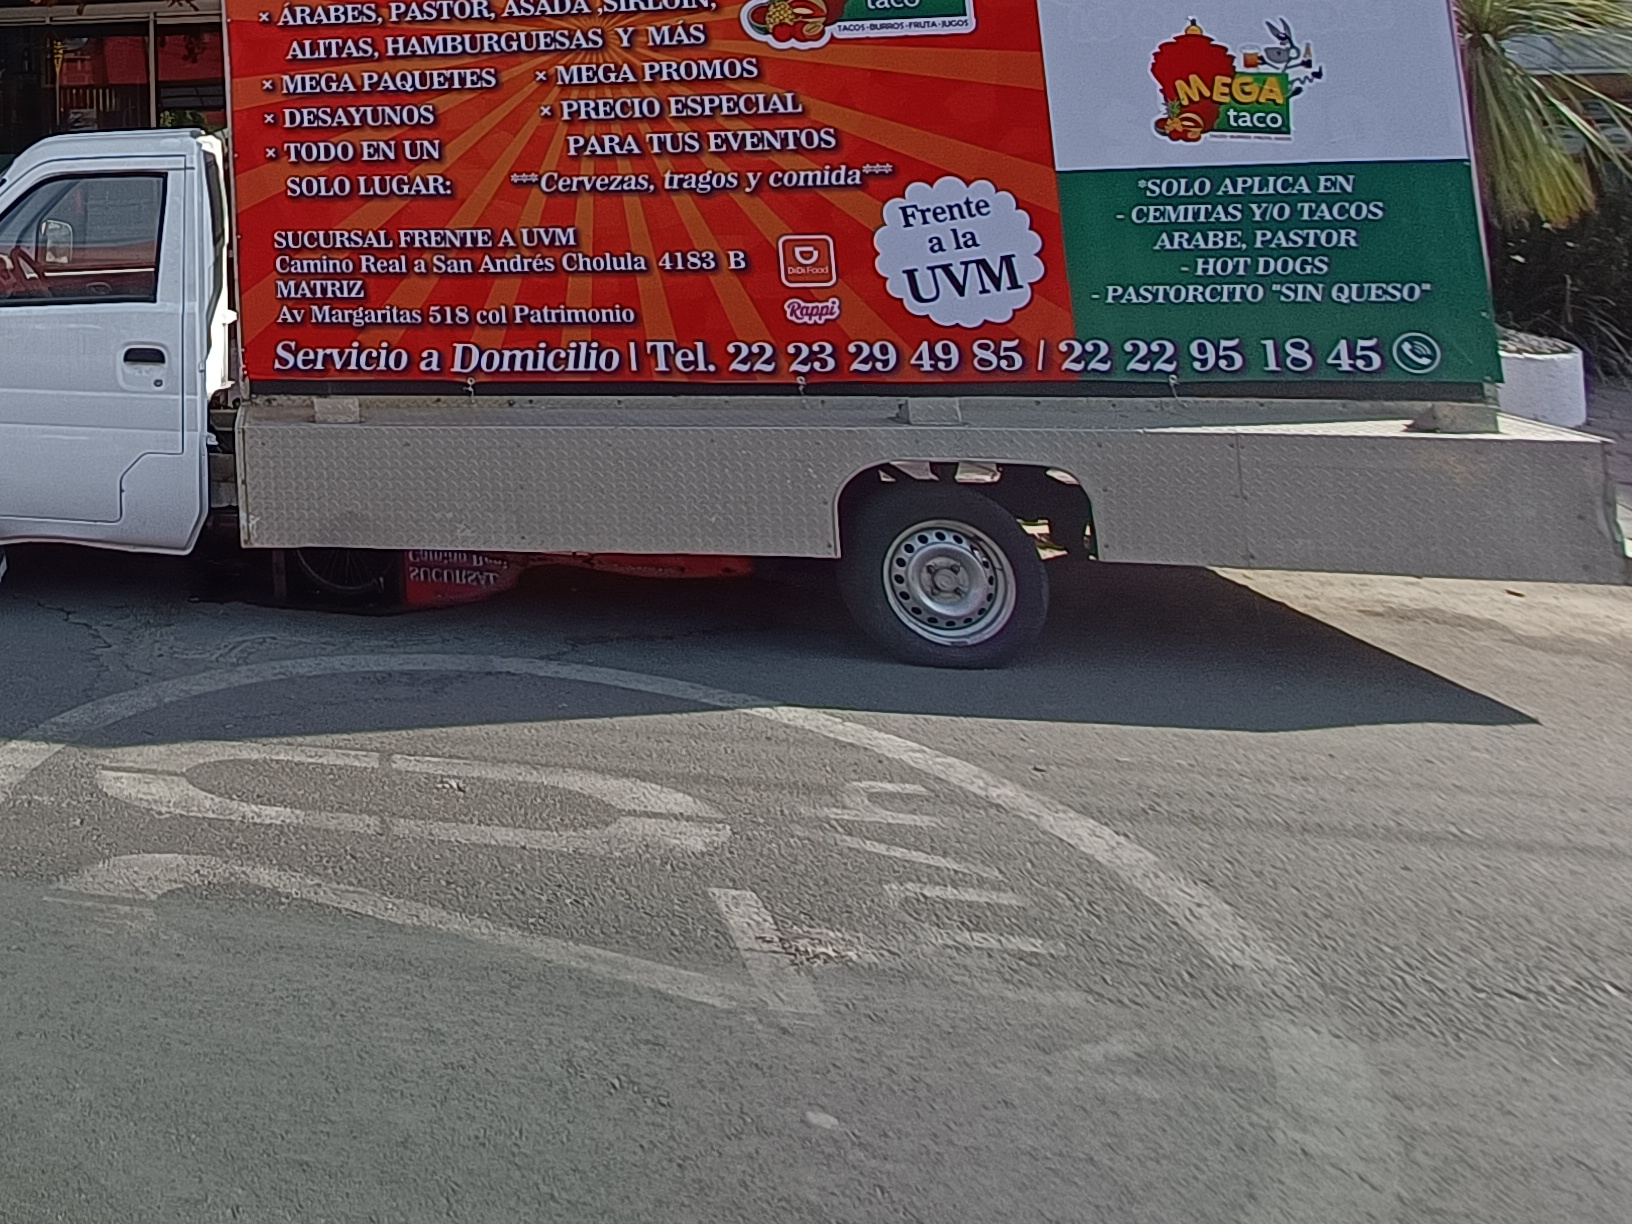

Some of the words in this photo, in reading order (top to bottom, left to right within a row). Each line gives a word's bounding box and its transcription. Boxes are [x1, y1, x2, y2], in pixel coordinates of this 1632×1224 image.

[276, 2, 384, 27] ÁRABES,
[285, 37, 380, 60] ALITAS,
[385, 28, 604, 57] HAMBURGUESAS
[614, 27, 635, 48] Y
[647, 20, 706, 47] MÁS
[281, 72, 357, 94] MEGA
[361, 68, 497, 92] PAQUETES
[555, 62, 638, 86] MEGA
[643, 57, 759, 82] PROMOS
[1174, 73, 1285, 106] MEGA
[282, 104, 435, 128] DESAYUNOS
[560, 97, 661, 121] PRECIO
[668, 92, 803, 117] ESPECIAL
[1226, 108, 1283, 128] taco
[283, 141, 354, 163] TODO
[360, 140, 396, 161] EN
[403, 139, 441, 160] UN
[566, 134, 643, 156] PARA
[645, 131, 701, 154] TUS
[707, 127, 837, 152] EVENTOS
[286, 176, 352, 196] SOLO
[357, 175, 453, 196] LUGAR:
[664, 169, 739, 194] tragos
[744, 171, 762, 192] y
[1216, 175, 1313, 196] APLICA
[1317, 174, 1356, 194] EN
[898, 196, 991, 228] Frente
[1131, 203, 1243, 224] CEMITAS
[1249, 202, 1291, 222] Y/O
[1296, 200, 1385, 221] TACOS
[273, 230, 394, 249] SUCURSAL
[397, 229, 493, 248] FRENTE
[497, 228, 517, 247] A
[520, 227, 578, 247] UVM
[928, 234, 946, 254] a
[950, 228, 980, 250] la
[1153, 229, 1248, 251] ARABE,
[1254, 228, 1359, 249] PASTOR
[275, 254, 354, 274] Camino
[359, 254, 408, 274] Real
[413, 258, 427, 274] a
[432, 254, 473, 273] San
[478, 253, 556, 273] Andrés
[561, 252, 648, 272] Cholula
[658, 251, 716, 270] 4183
[727, 250, 747, 270] B
[807, 265, 829, 274] Food
[1194, 257, 1251, 277] HOT
[1256, 256, 1330, 276] DOGS
[275, 280, 365, 299] MATRIZ
[901, 253, 1024, 304] UVM
[1105, 284, 1264, 304] PASTORCITO
[1272, 283, 1326, 303] "SIN
[1331, 282, 1432, 305] QUESO"
[276, 304, 305, 324] Av
[309, 304, 422, 327] Margaritas
[428, 305, 470, 325] 518
[475, 305, 508, 325] col
[512, 304, 636, 324] Patrimonio
[786, 299, 839, 322] Rappi
[273, 340, 409, 371] Servicio
[419, 348, 441, 372] a
[450, 340, 620, 373] Domicilio
[646, 340, 717, 373] Tel.
[726, 341, 777, 373] 22
[786, 341, 837, 373] 23
[847, 341, 897, 373] 29
[909, 340, 960, 372] 49
[972, 339, 1024, 372] 85
[1058, 338, 1112, 372] 22
[1123, 338, 1178, 372] 22
[1189, 338, 1244, 371] 95
[1261, 338, 1314, 371] 18
[1325, 338, 1383, 371] 45
